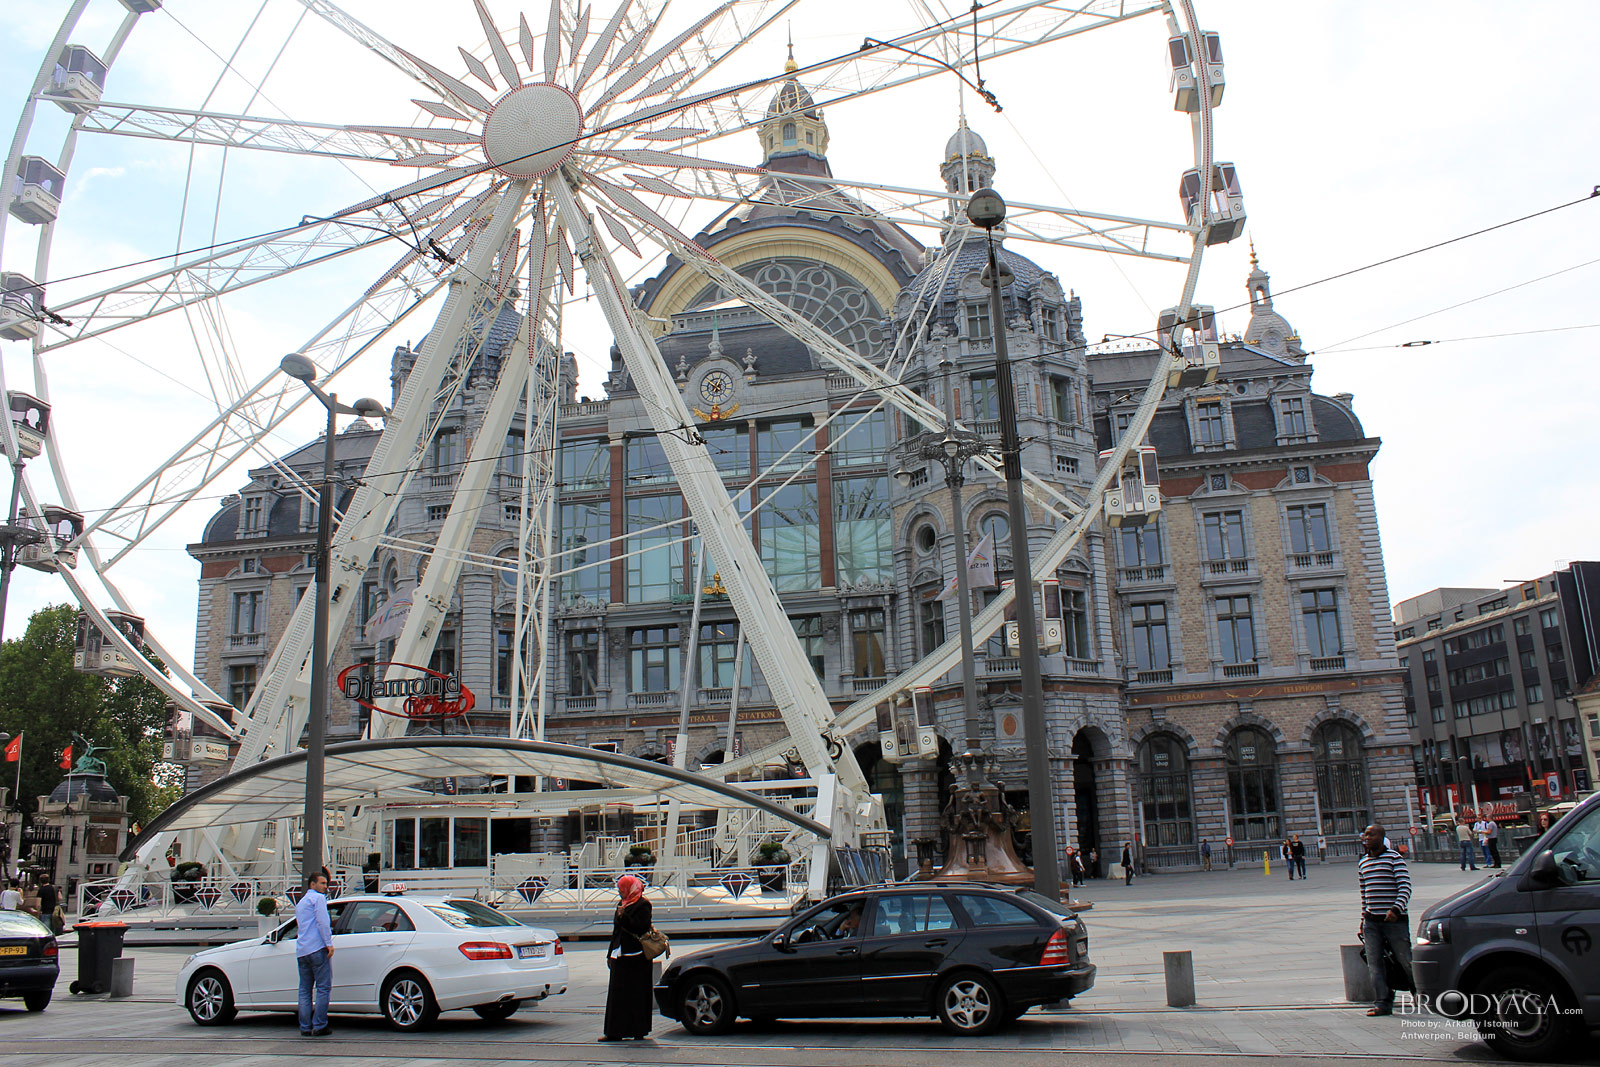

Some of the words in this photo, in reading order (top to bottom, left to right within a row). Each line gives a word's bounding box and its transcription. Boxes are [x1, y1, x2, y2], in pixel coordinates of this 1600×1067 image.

[344, 669, 460, 700] Diamond
[671, 715, 717, 725] CTRAAL
[738, 711, 775, 720] STATION
[1493, 802, 1518, 814] Markt
[391, 883, 407, 891] TAXI
